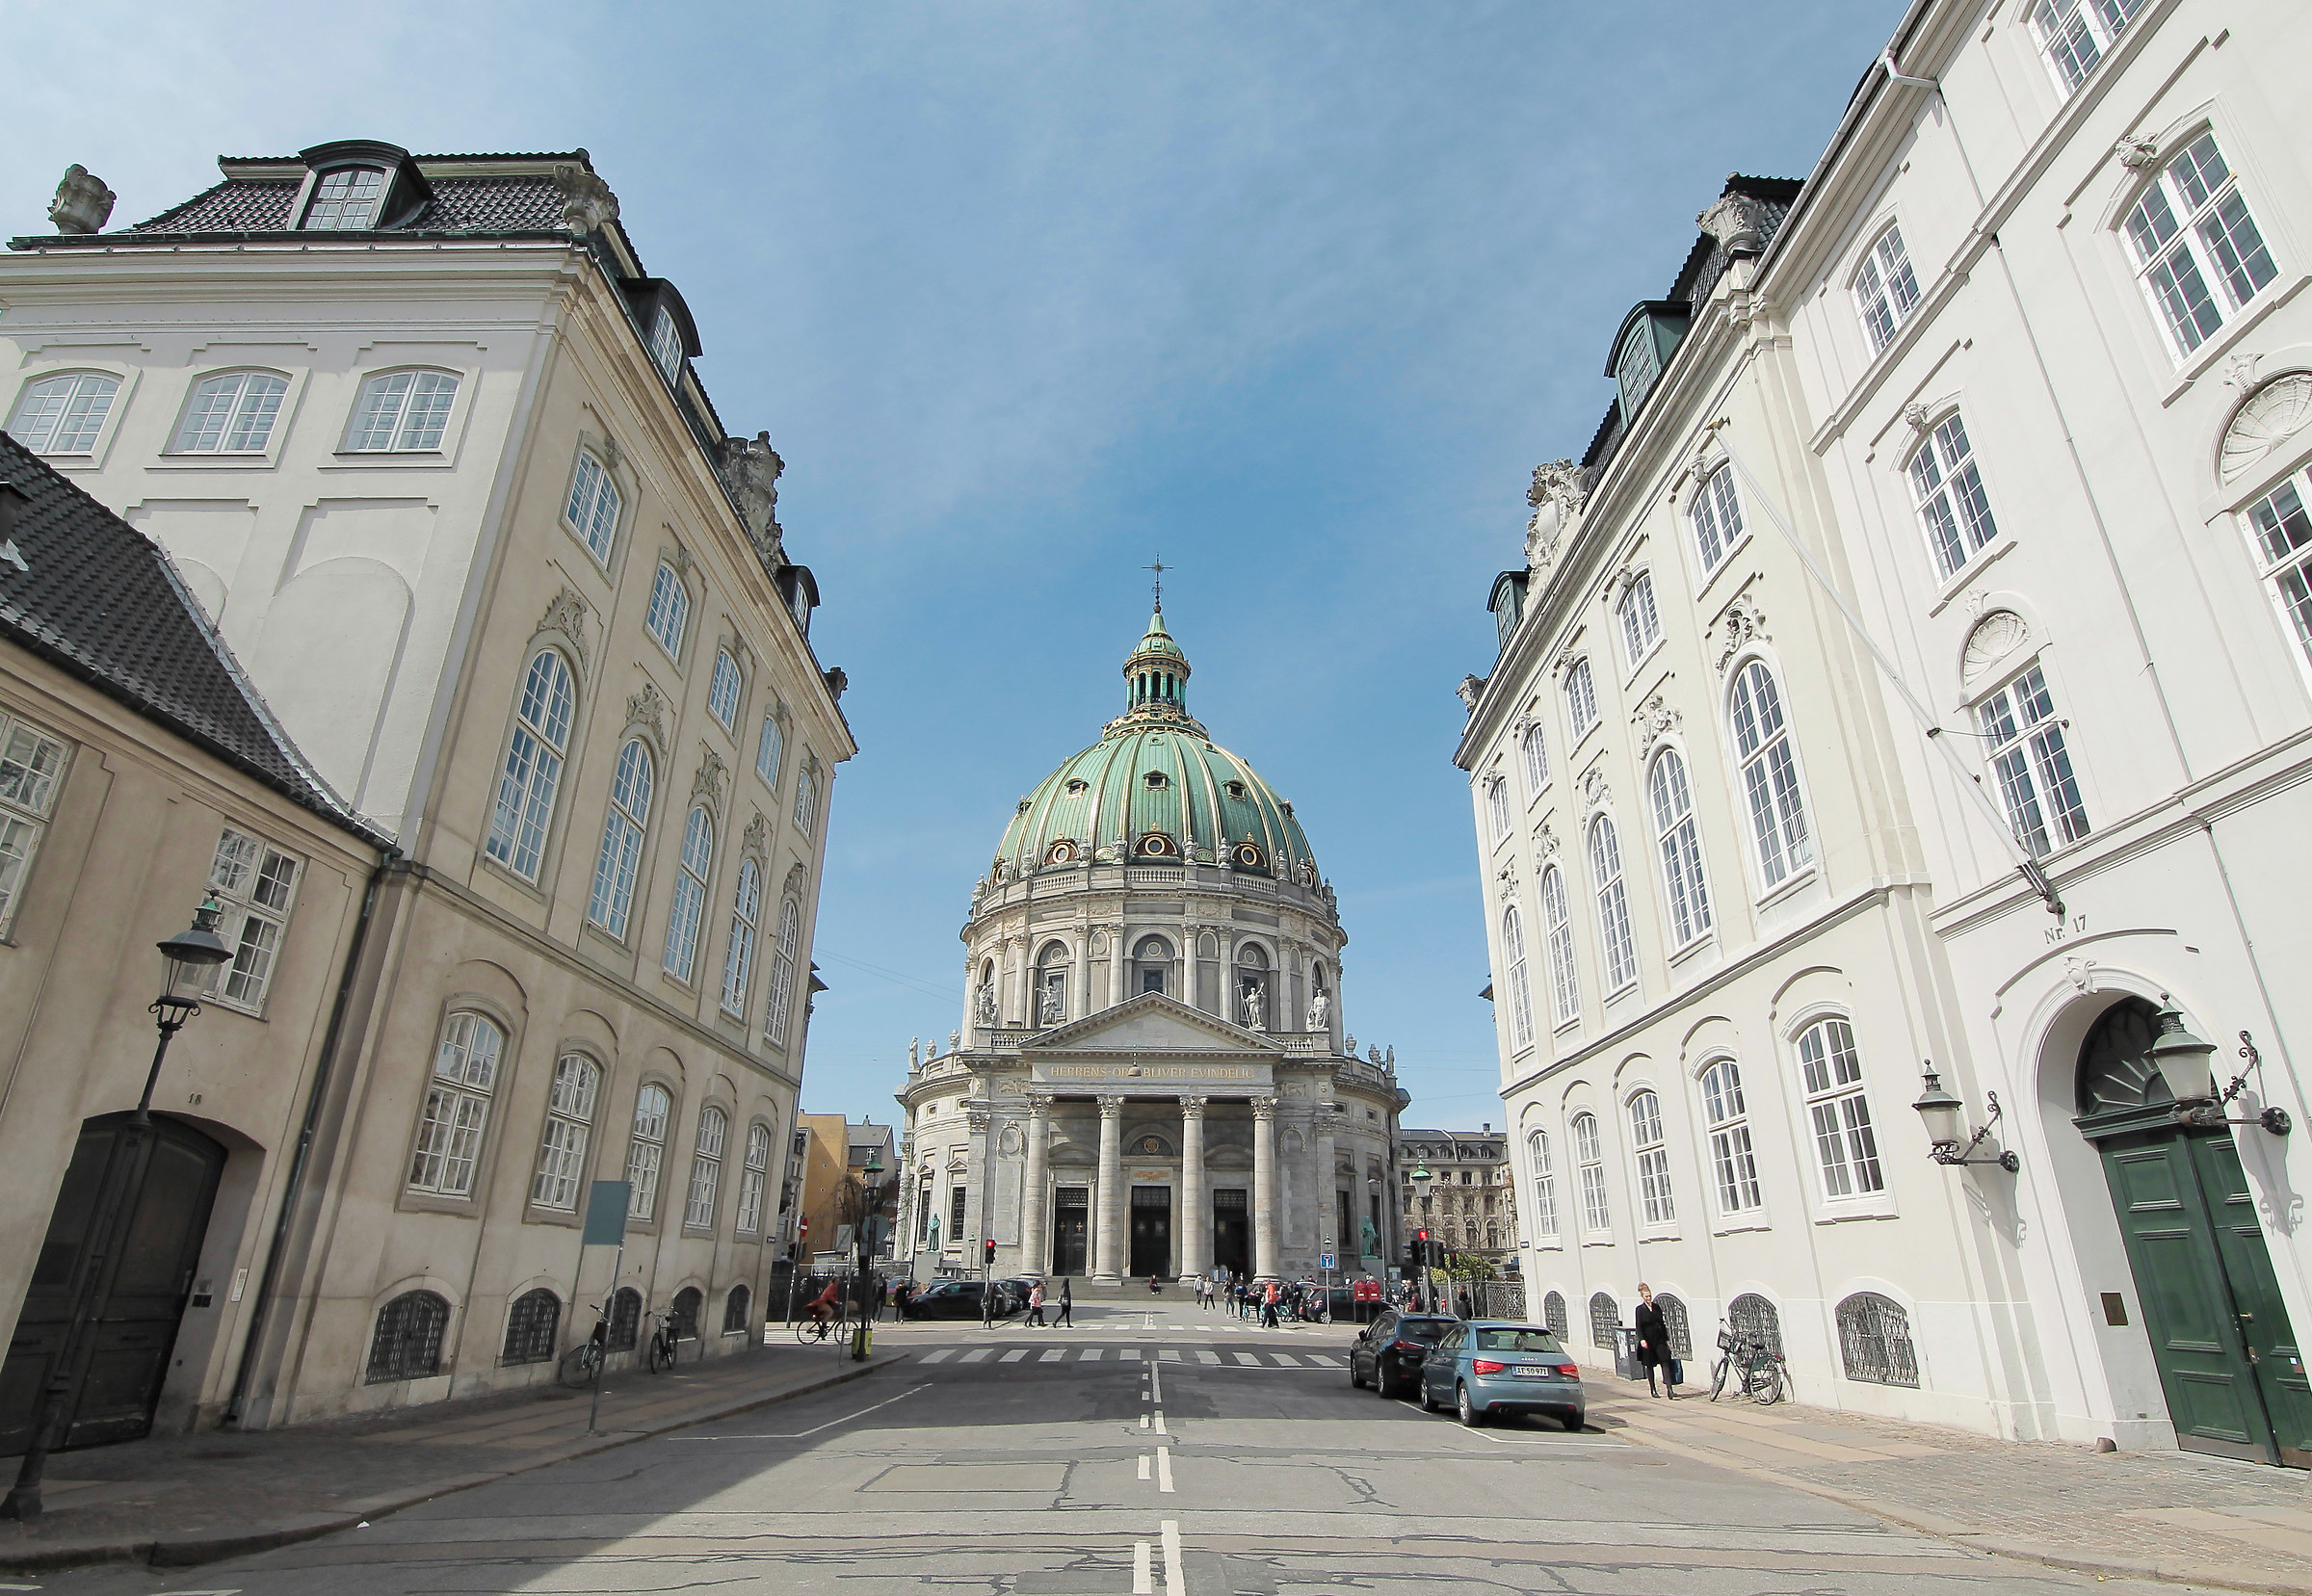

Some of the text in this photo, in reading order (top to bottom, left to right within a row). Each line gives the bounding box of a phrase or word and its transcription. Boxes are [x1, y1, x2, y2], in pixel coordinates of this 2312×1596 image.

[2043, 914, 2087, 944] Nr. 17
[1051, 1066, 1107, 1078] HERRENS
[1143, 1067, 1186, 1078] BLIVER
[188, 1092, 202, 1106] 18
